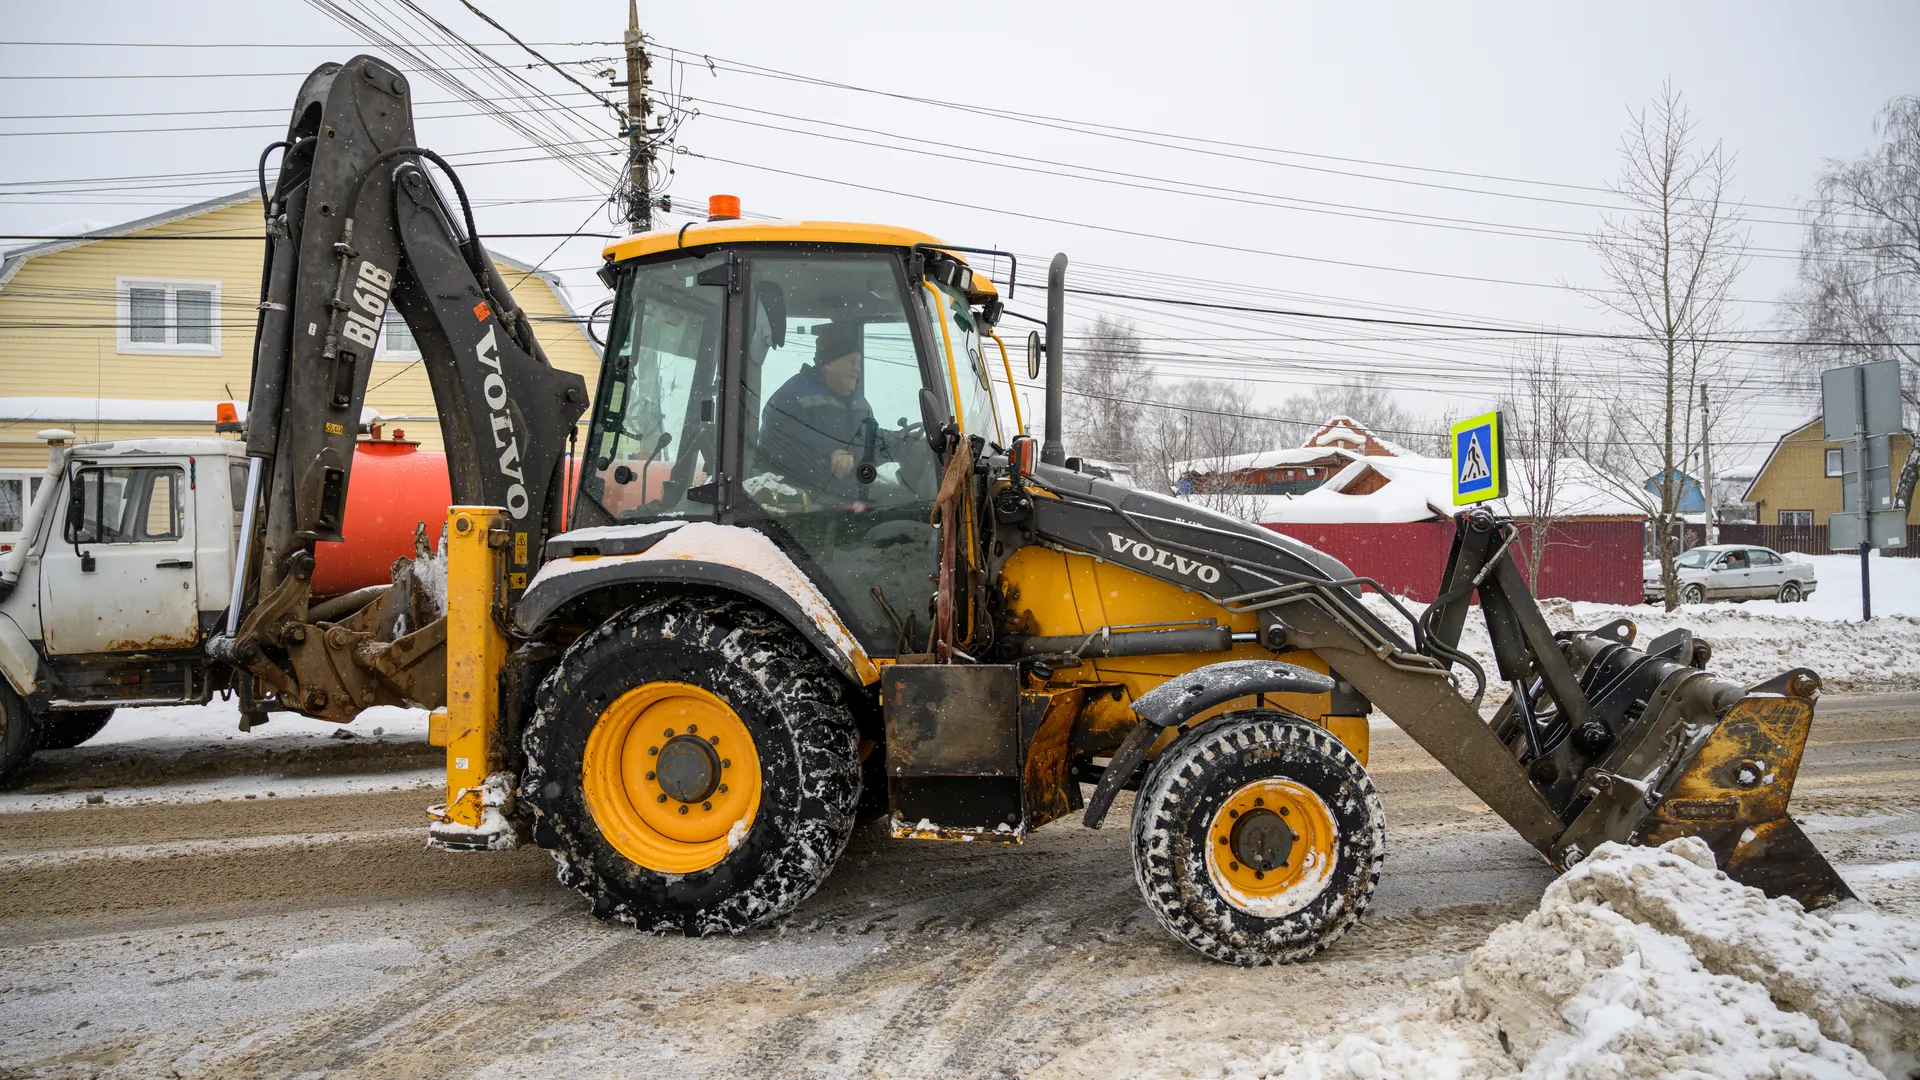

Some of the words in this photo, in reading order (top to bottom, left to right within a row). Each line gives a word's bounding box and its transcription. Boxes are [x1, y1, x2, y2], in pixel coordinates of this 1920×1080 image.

[343, 261, 392, 349] BL61B
[475, 324, 529, 520] VOLVO
[1108, 532, 1220, 584] VOLVO
